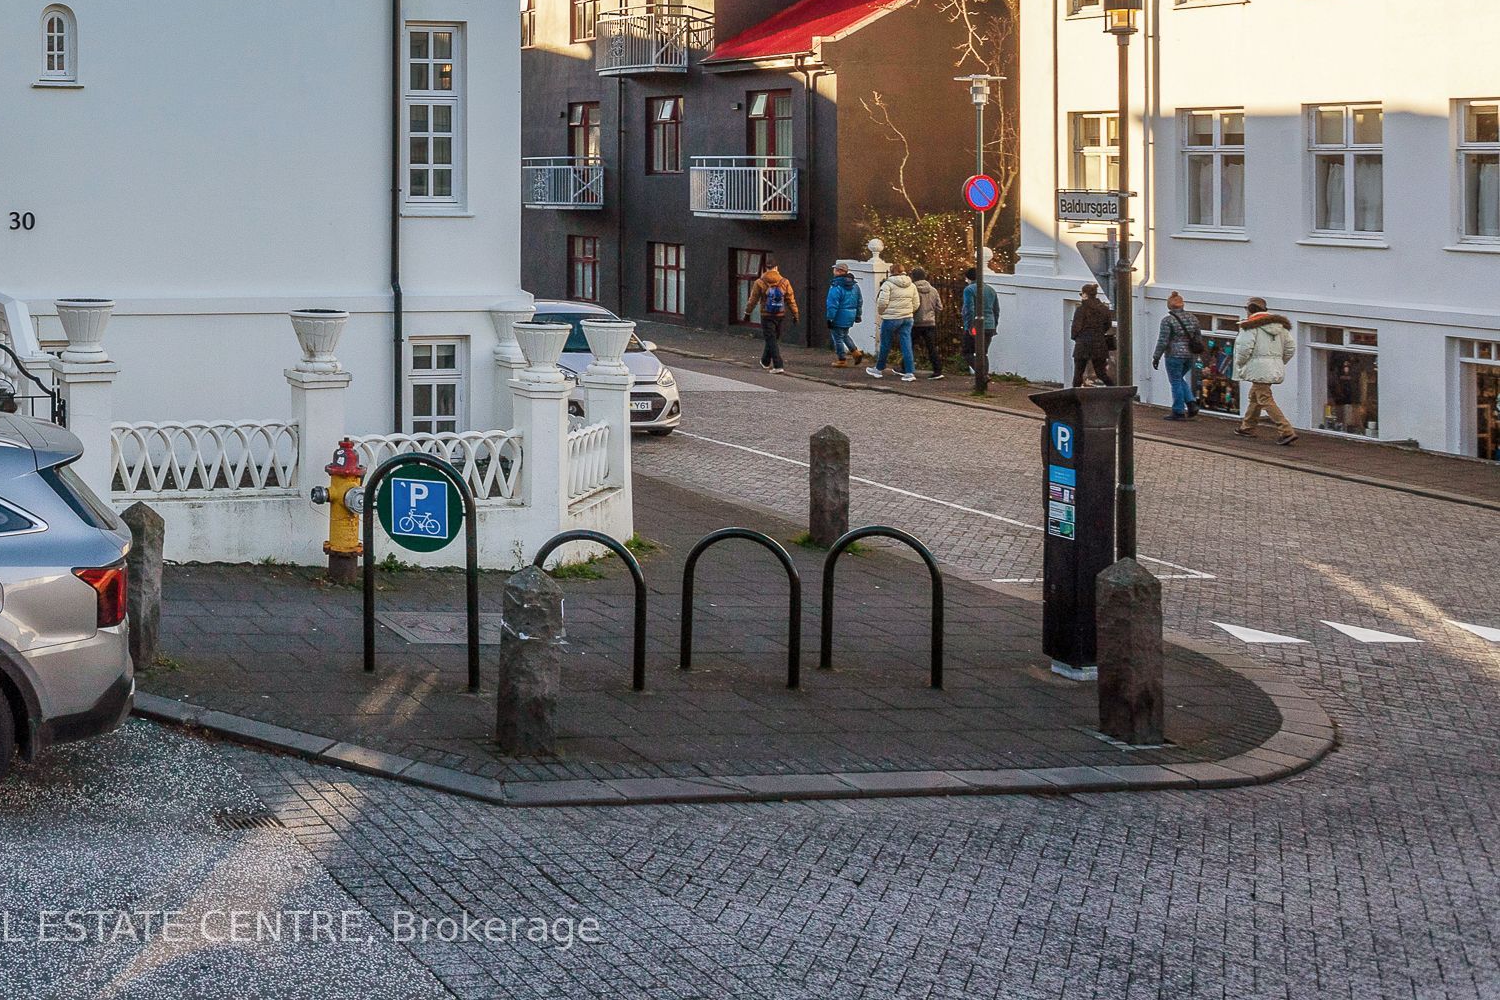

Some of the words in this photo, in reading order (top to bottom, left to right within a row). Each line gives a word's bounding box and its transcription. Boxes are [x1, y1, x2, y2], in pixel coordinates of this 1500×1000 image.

[1060, 199, 1118, 217] Baldursgata
[9, 211, 36, 231] 30
[634, 402, 649, 410] Y61
[410, 483, 429, 508] P
